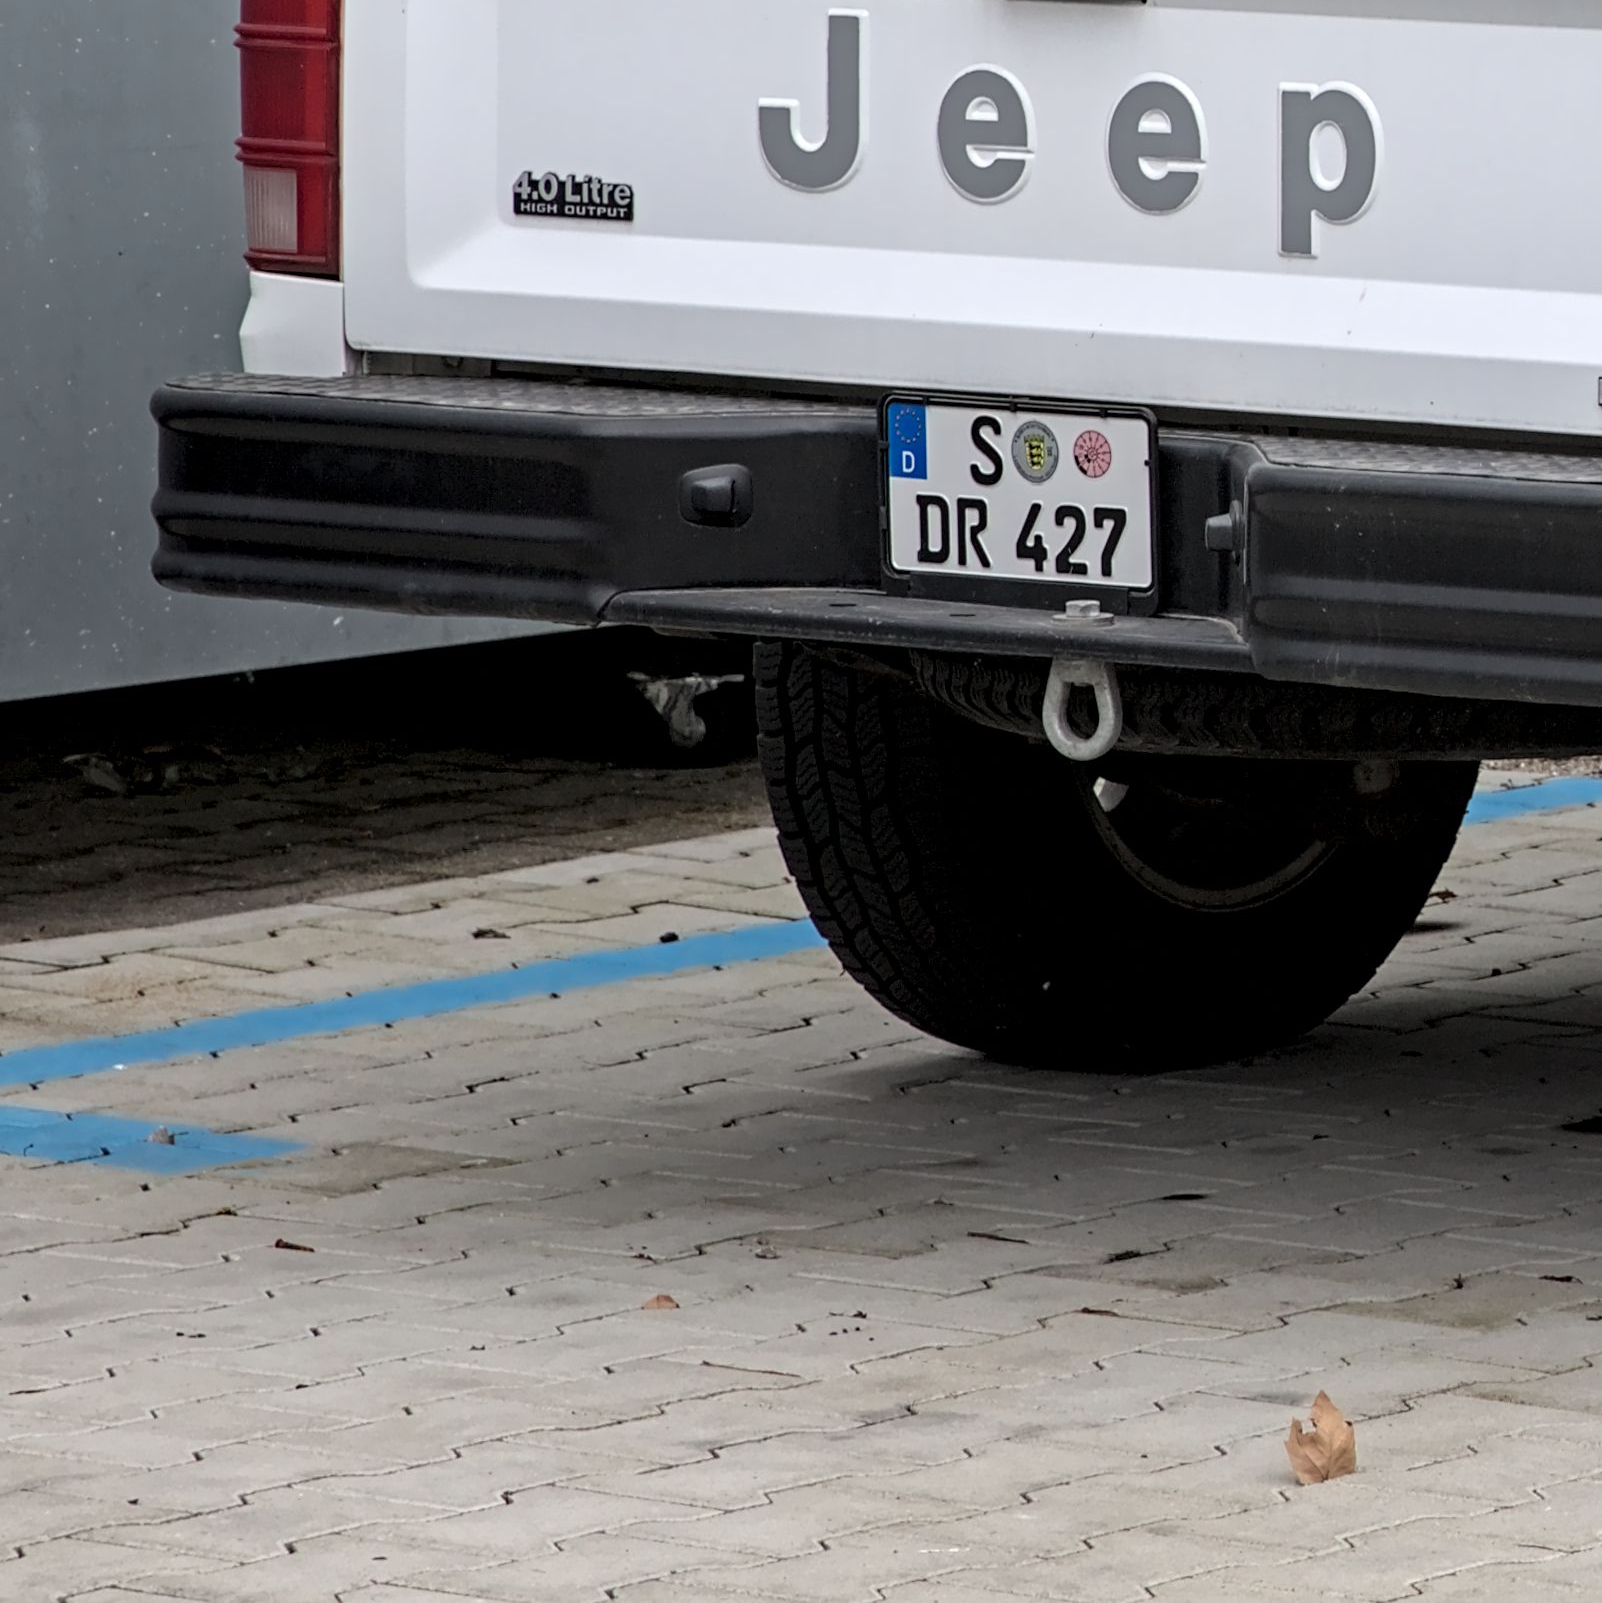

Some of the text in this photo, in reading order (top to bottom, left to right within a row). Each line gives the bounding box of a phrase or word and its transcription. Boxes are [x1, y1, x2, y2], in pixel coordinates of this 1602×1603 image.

[758, 8, 1384, 259] Jeep
[513, 171, 632, 206] 4.0 Litre
[520, 202, 628, 218] HIGH OUTPUT
[902, 451, 915, 473] D
[970, 415, 1003, 486] S
[916, 494, 1128, 577] DR 427
